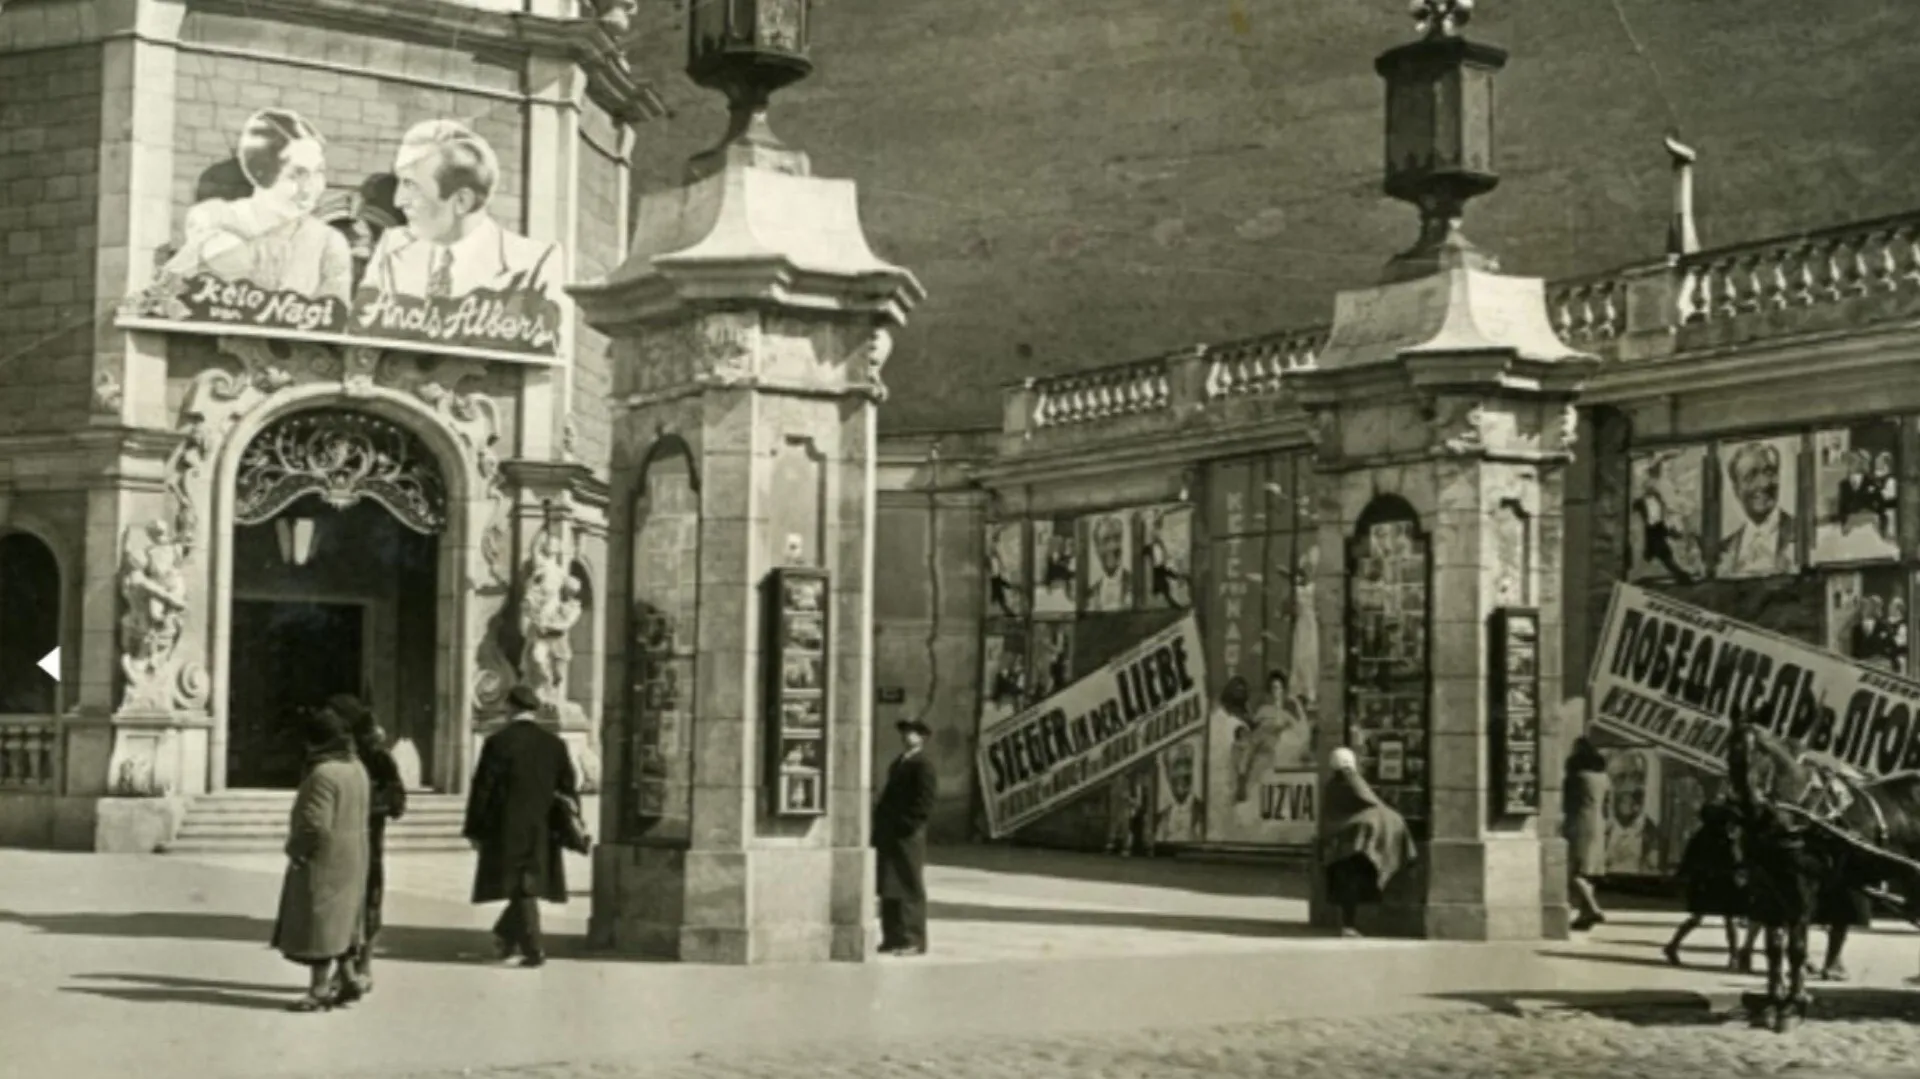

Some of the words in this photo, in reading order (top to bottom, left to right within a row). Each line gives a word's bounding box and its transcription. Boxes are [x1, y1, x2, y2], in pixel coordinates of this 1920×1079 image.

[988, 707, 1076, 793] SIEGER
[1117, 635, 1195, 721] LIEBE
[1610, 607, 1817, 741] ПОБЕДИТЕЛЬ
[1260, 783, 1316, 822] UZVA
